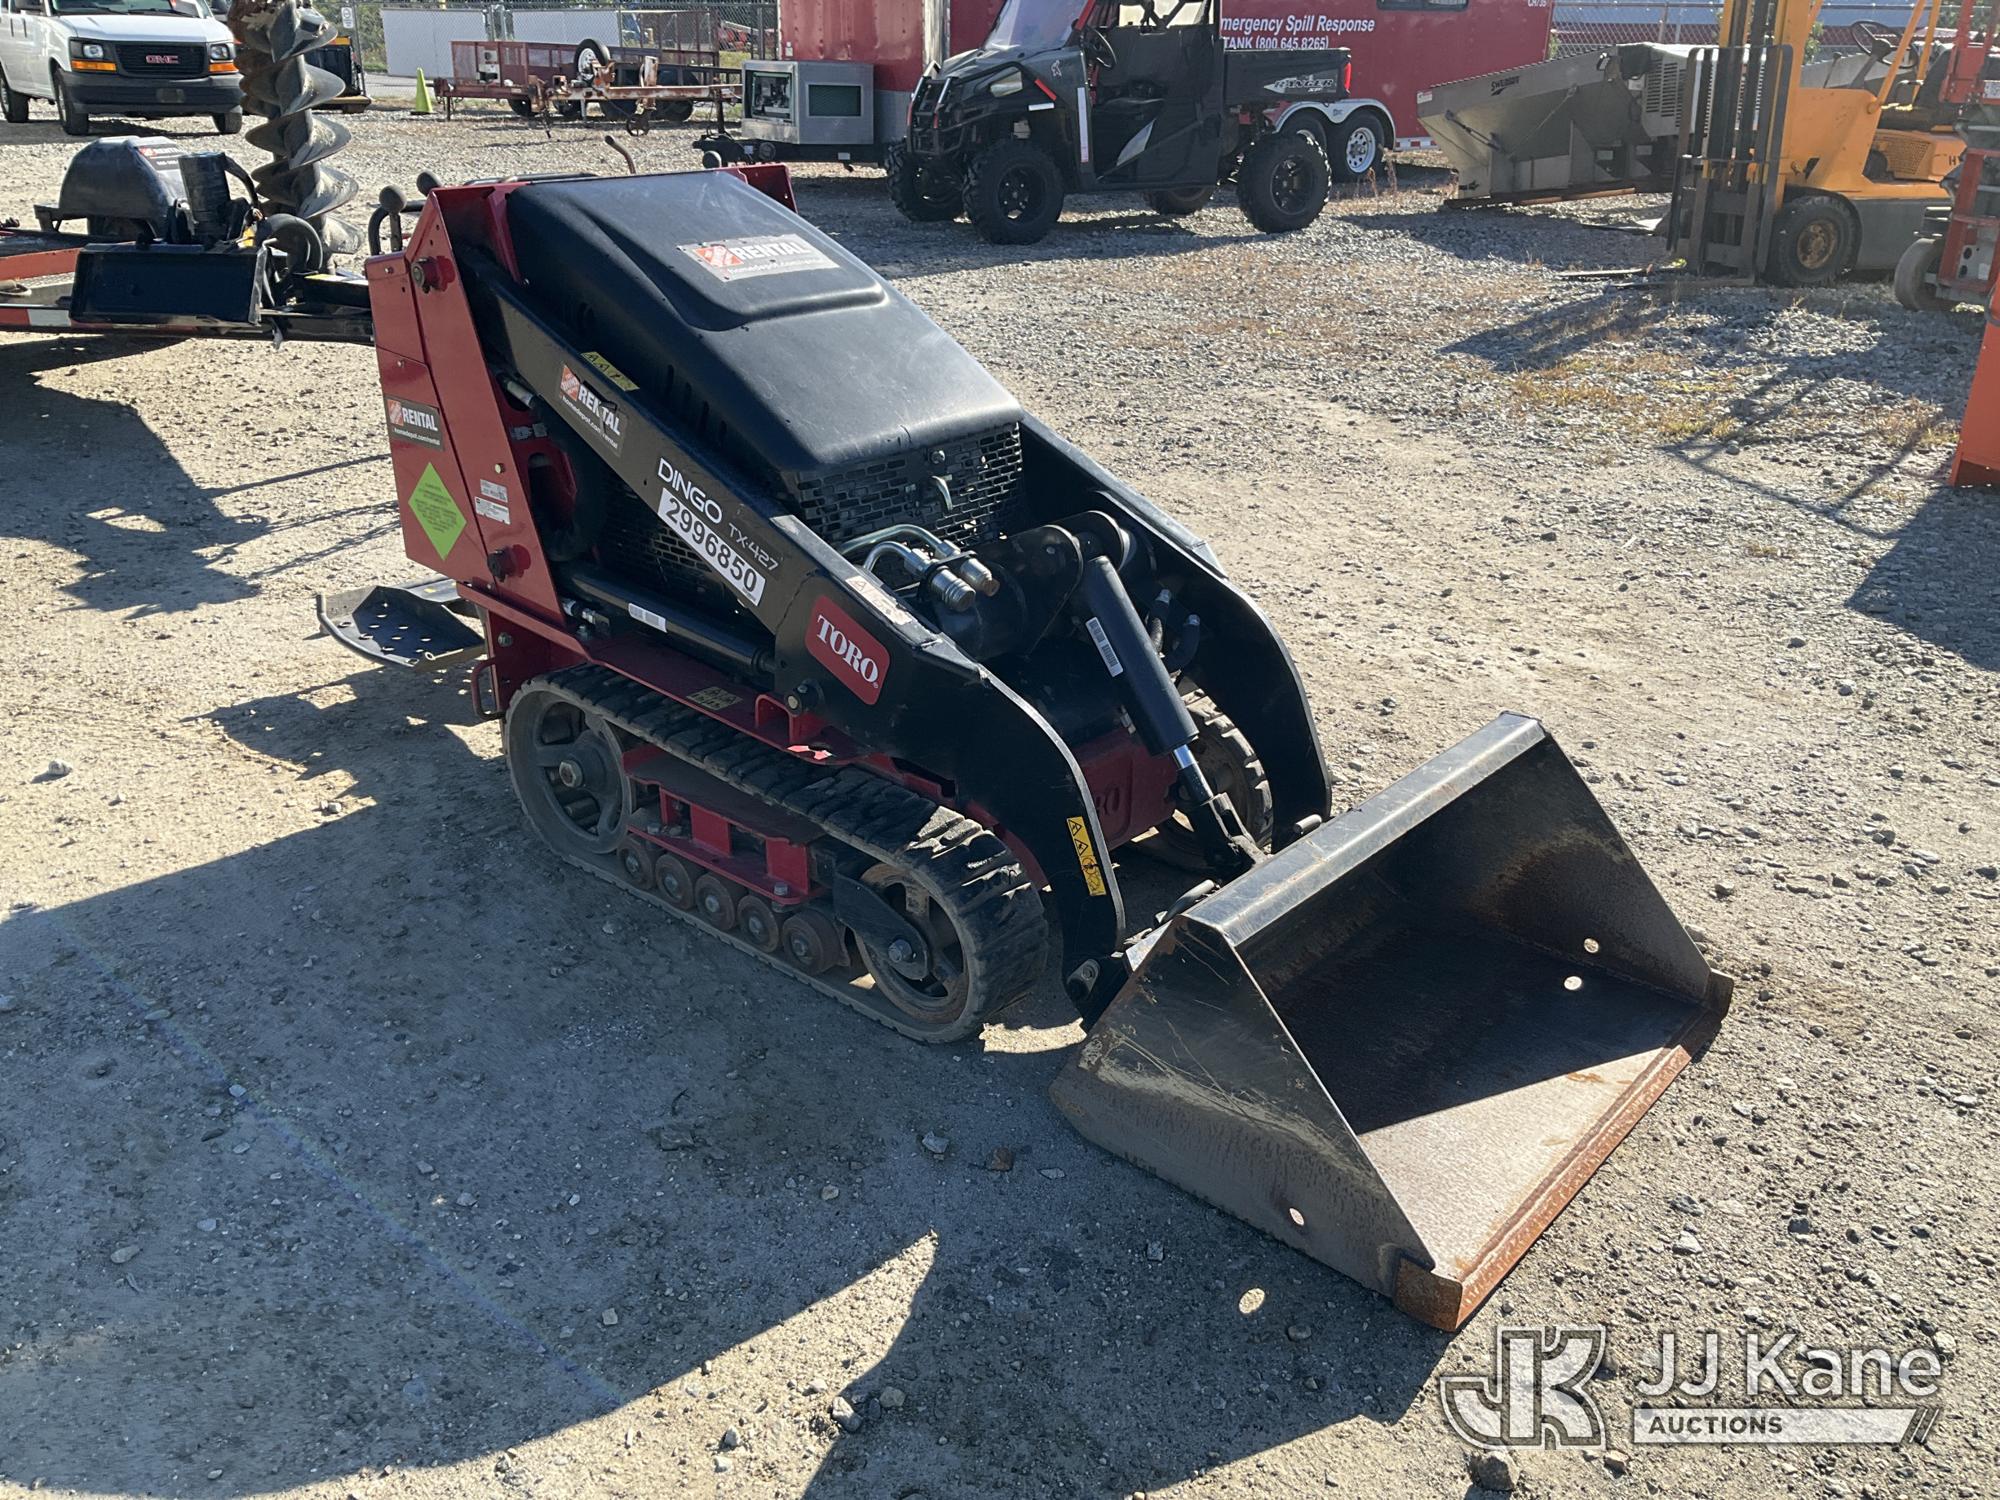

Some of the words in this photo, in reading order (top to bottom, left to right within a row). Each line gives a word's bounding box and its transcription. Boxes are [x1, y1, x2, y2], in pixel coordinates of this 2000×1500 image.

[1221, 17, 1283, 35] mergency
[1286, 15, 1313, 35] Spill
[1317, 15, 1375, 35] Response
[1223, 37, 1252, 49] TANK
[145, 55, 179, 64] GMC
[1273, 79, 1334, 88] RANGER
[728, 242, 812, 260] RENTAL
[402, 407, 438, 432] RENTAL
[657, 457, 723, 524] DINGO
[665, 497, 757, 593] 2996850
